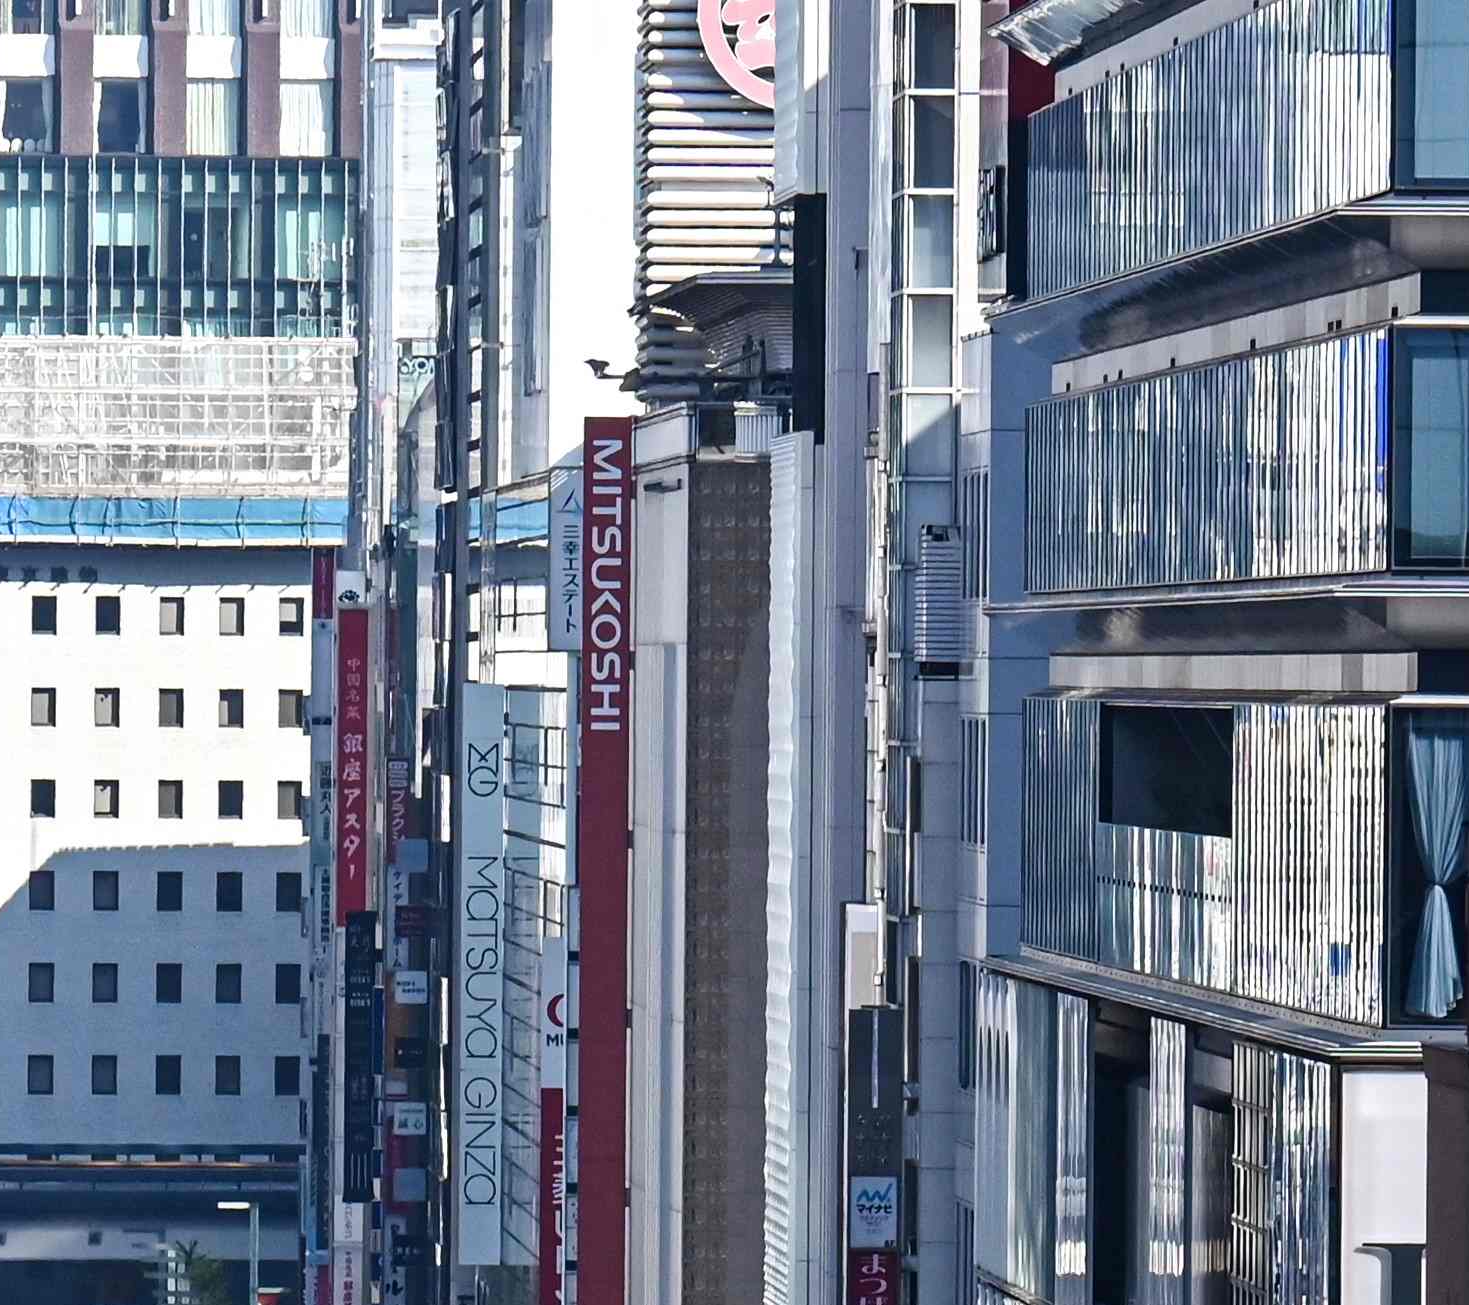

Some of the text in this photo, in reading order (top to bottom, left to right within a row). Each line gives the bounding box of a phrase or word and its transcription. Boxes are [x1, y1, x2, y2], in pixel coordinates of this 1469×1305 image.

[561, 524, 577, 634] 三幸エステート
[589, 439, 623, 732] MITSUKOSHI
[342, 732, 363, 881] 銀座アスター
[855, 1203, 893, 1215] マイナビ
